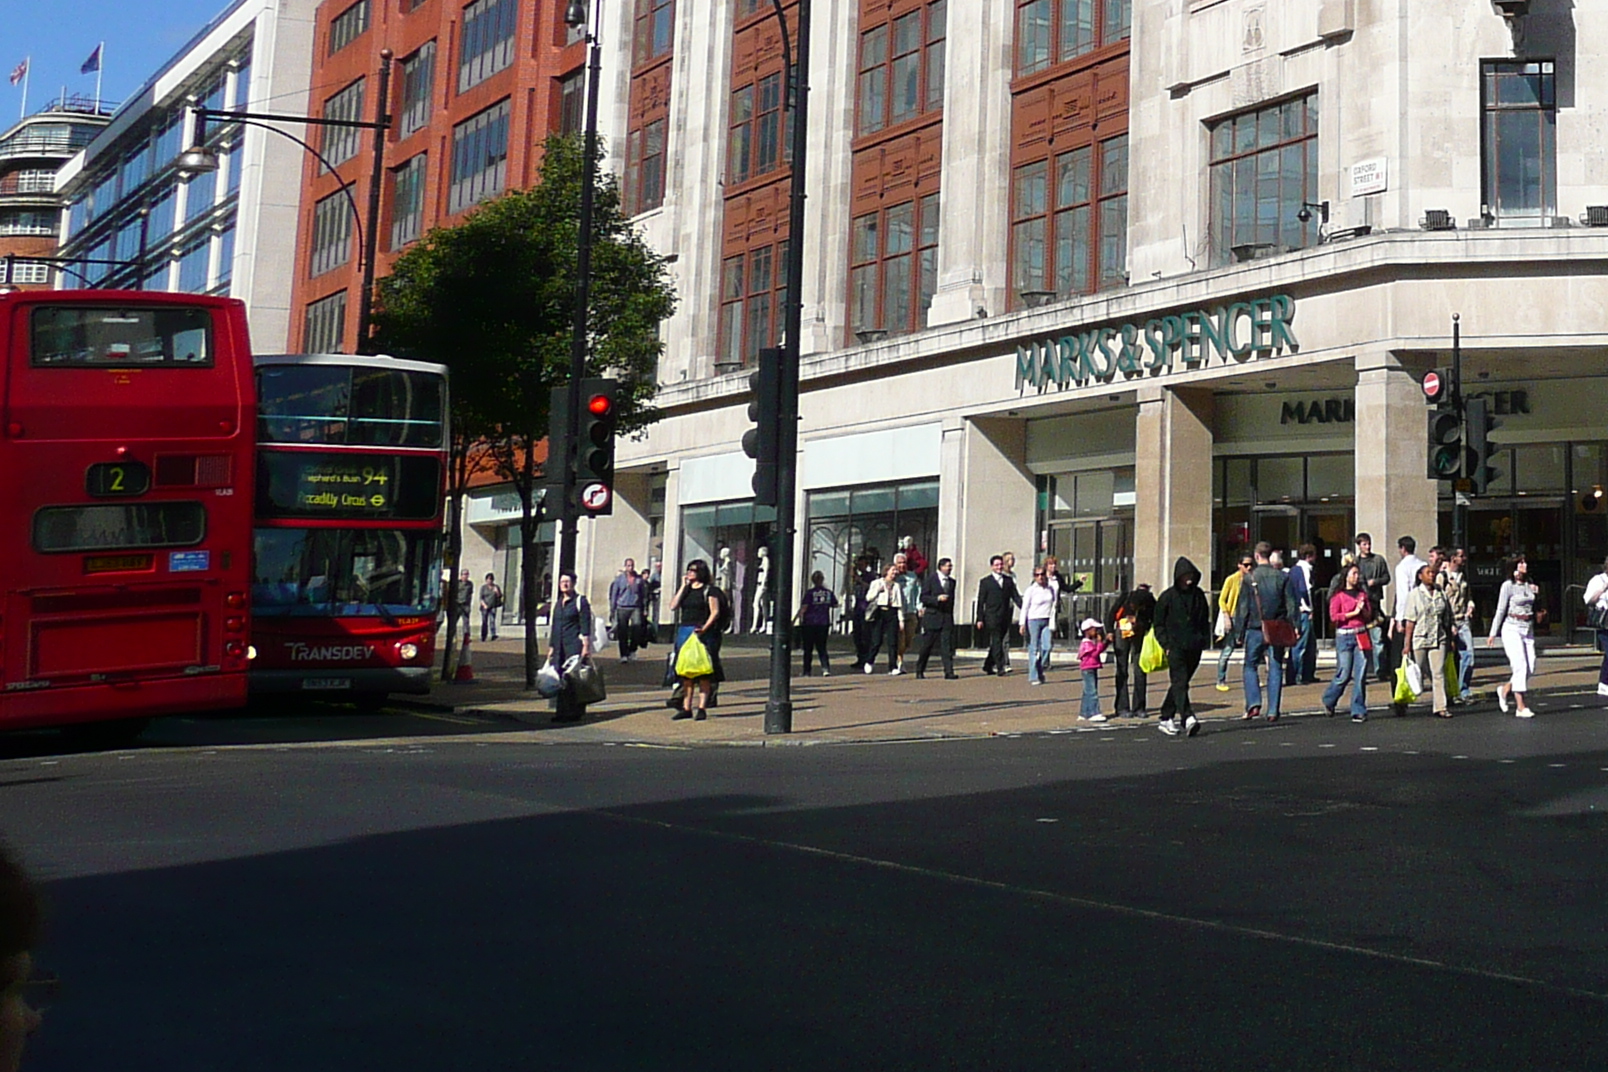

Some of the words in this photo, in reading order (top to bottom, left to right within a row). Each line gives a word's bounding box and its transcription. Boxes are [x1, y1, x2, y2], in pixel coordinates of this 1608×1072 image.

[1354, 162, 1377, 175] OXFORD
[1354, 173, 1374, 185] STREET
[110, 467, 125, 491] 2
[361, 467, 388, 485] 94
[284, 642, 375, 661] TRANSDEV
